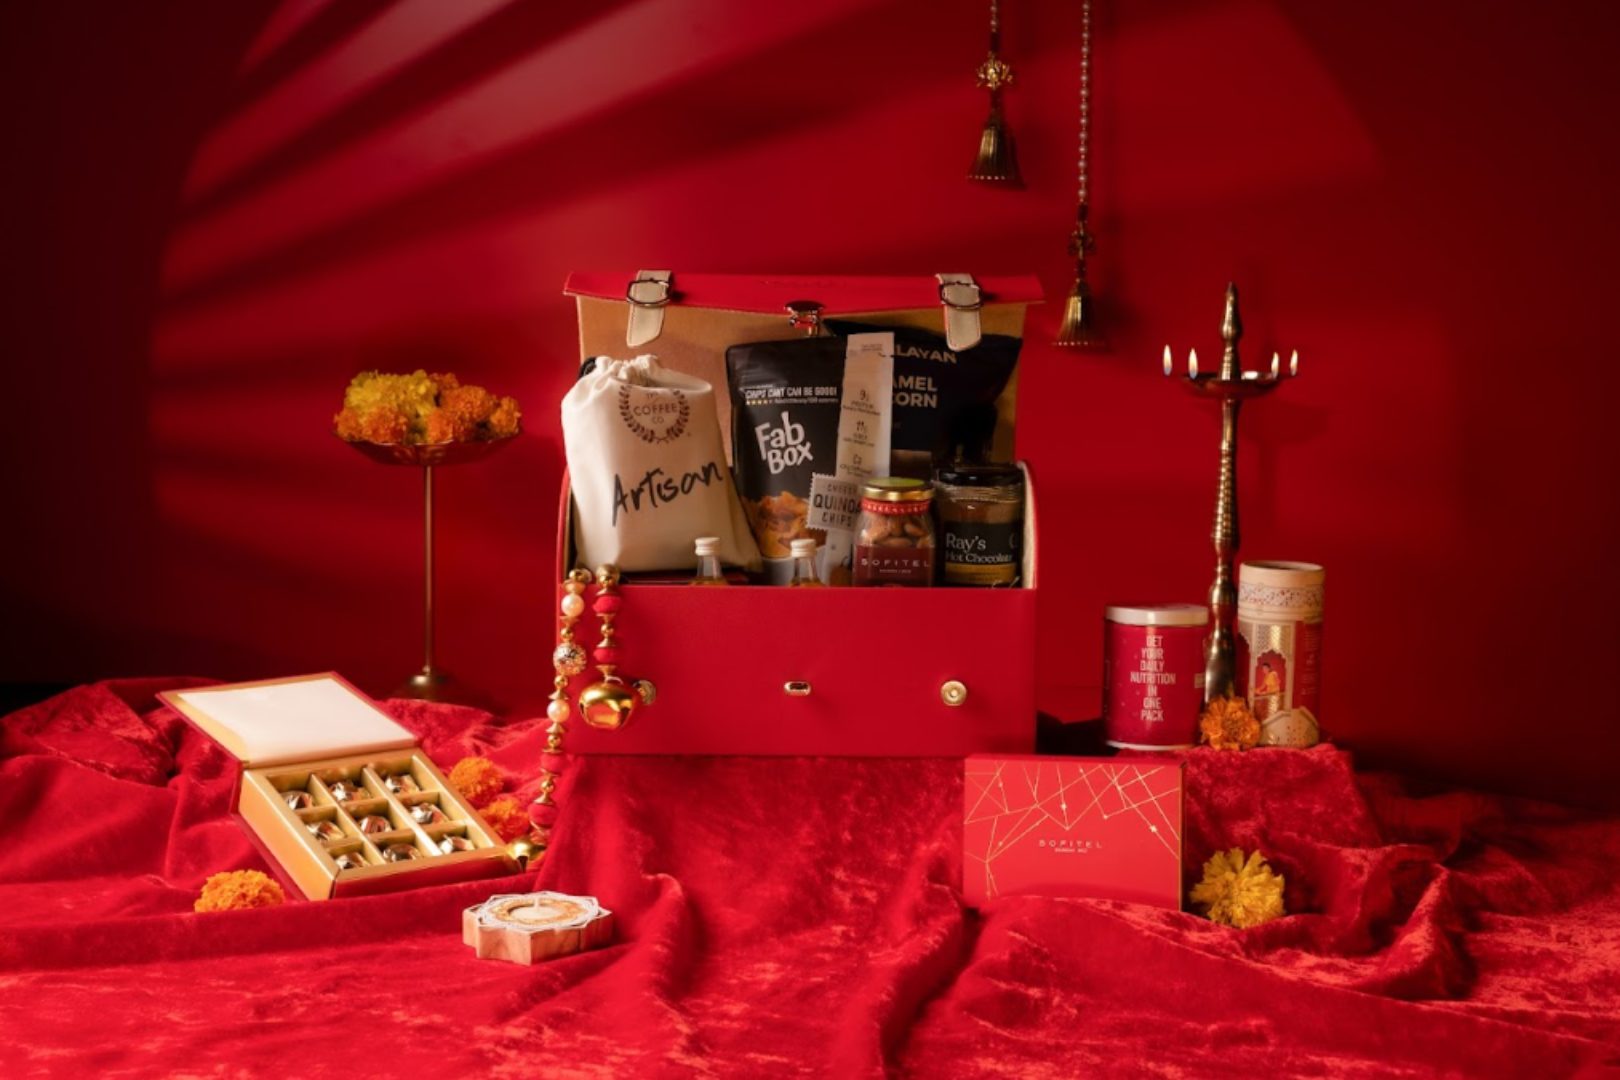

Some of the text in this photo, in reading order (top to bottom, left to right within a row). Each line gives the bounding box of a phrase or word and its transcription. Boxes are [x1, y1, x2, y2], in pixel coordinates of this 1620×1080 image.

[786, 386, 802, 397] CAN
[803, 386, 814, 396] BE
[893, 392, 938, 409] ORN
[633, 402, 678, 416] COFFEE
[755, 411, 805, 461] Fab
[767, 441, 814, 475] Box
[612, 461, 724, 528] Artisan
[822, 511, 852, 527] CHIPS
[945, 532, 987, 553] Ray's
[860, 557, 931, 568] SOFITEL
[1146, 635, 1163, 647] GET
[1141, 647, 1164, 660] YOUR
[1140, 660, 1165, 672] DAILY
[1130, 671, 1176, 685] NUTRITION
[1147, 685, 1158, 697] IN
[1143, 697, 1162, 709] ONE
[1140, 709, 1164, 722] PACK
[1039, 839, 1102, 849] SOFITEL
